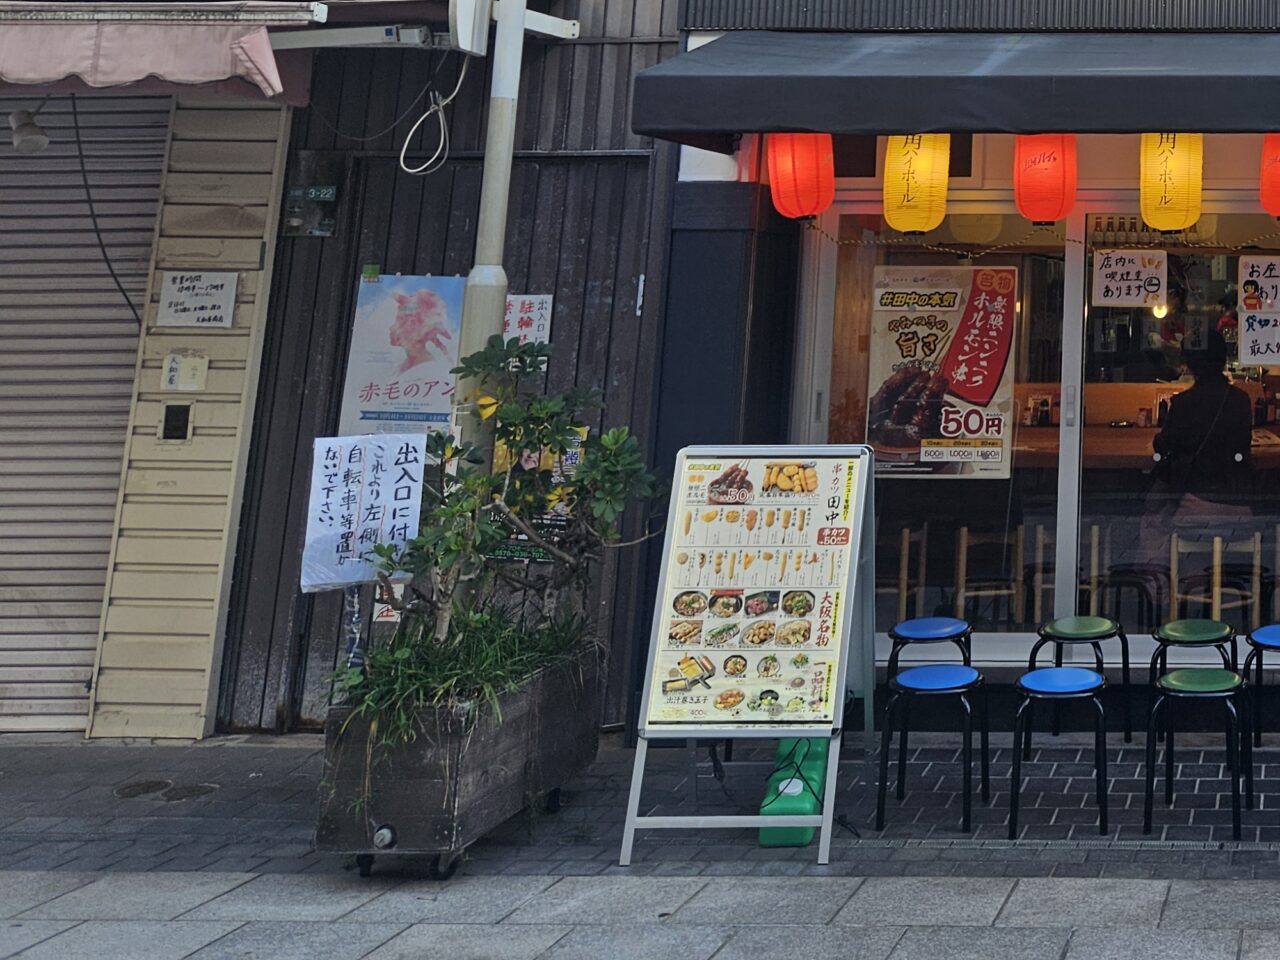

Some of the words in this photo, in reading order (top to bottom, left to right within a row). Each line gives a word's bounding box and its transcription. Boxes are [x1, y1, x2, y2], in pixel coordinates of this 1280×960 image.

[308, 189, 333, 198] 3-22
[1100, 255, 1136, 270] 店内に
[1103, 283, 1144, 299] あります
[896, 331, 939, 359] 旨さ
[358, 380, 456, 403] 赤毛のアン
[940, 407, 1004, 438] 50円
[358, 445, 388, 564] これより左側に
[825, 462, 843, 526] 串カツ田中
[815, 591, 834, 647] 大阪名物
